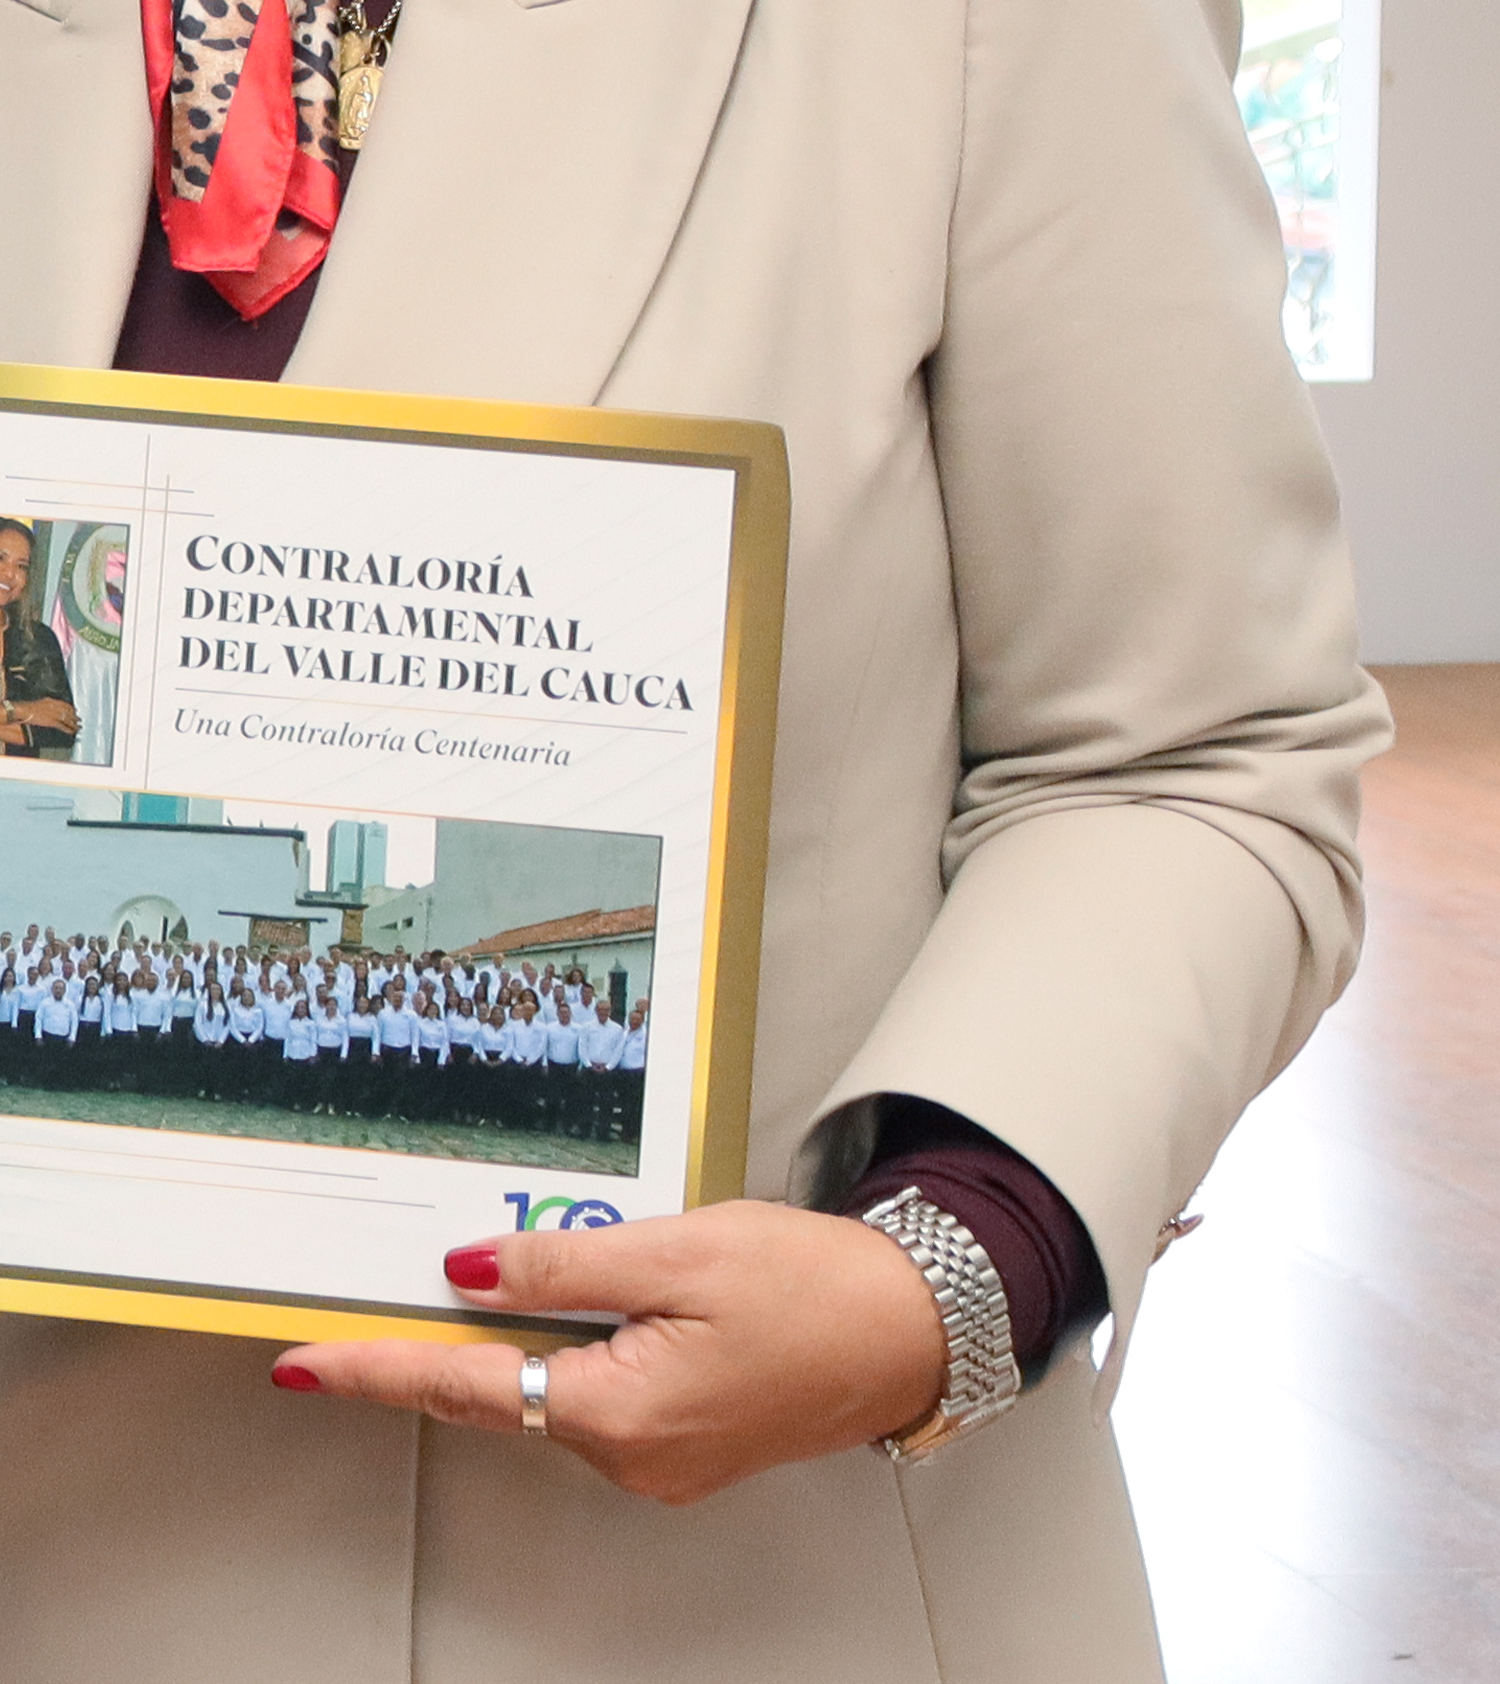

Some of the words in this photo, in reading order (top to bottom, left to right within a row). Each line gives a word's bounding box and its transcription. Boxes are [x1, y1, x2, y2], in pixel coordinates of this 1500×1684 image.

[185, 534, 535, 599] CONTRALORÍA
[181, 586, 594, 653] DEPARTAMENTAL
[177, 635, 271, 675] DEL
[280, 643, 427, 689] VALLE
[437, 657, 531, 697] DEL
[540, 666, 695, 712] CAUCA
[174, 707, 232, 737] Una
[240, 713, 406, 753] Contraloría
[414, 728, 572, 767] Centenaria
